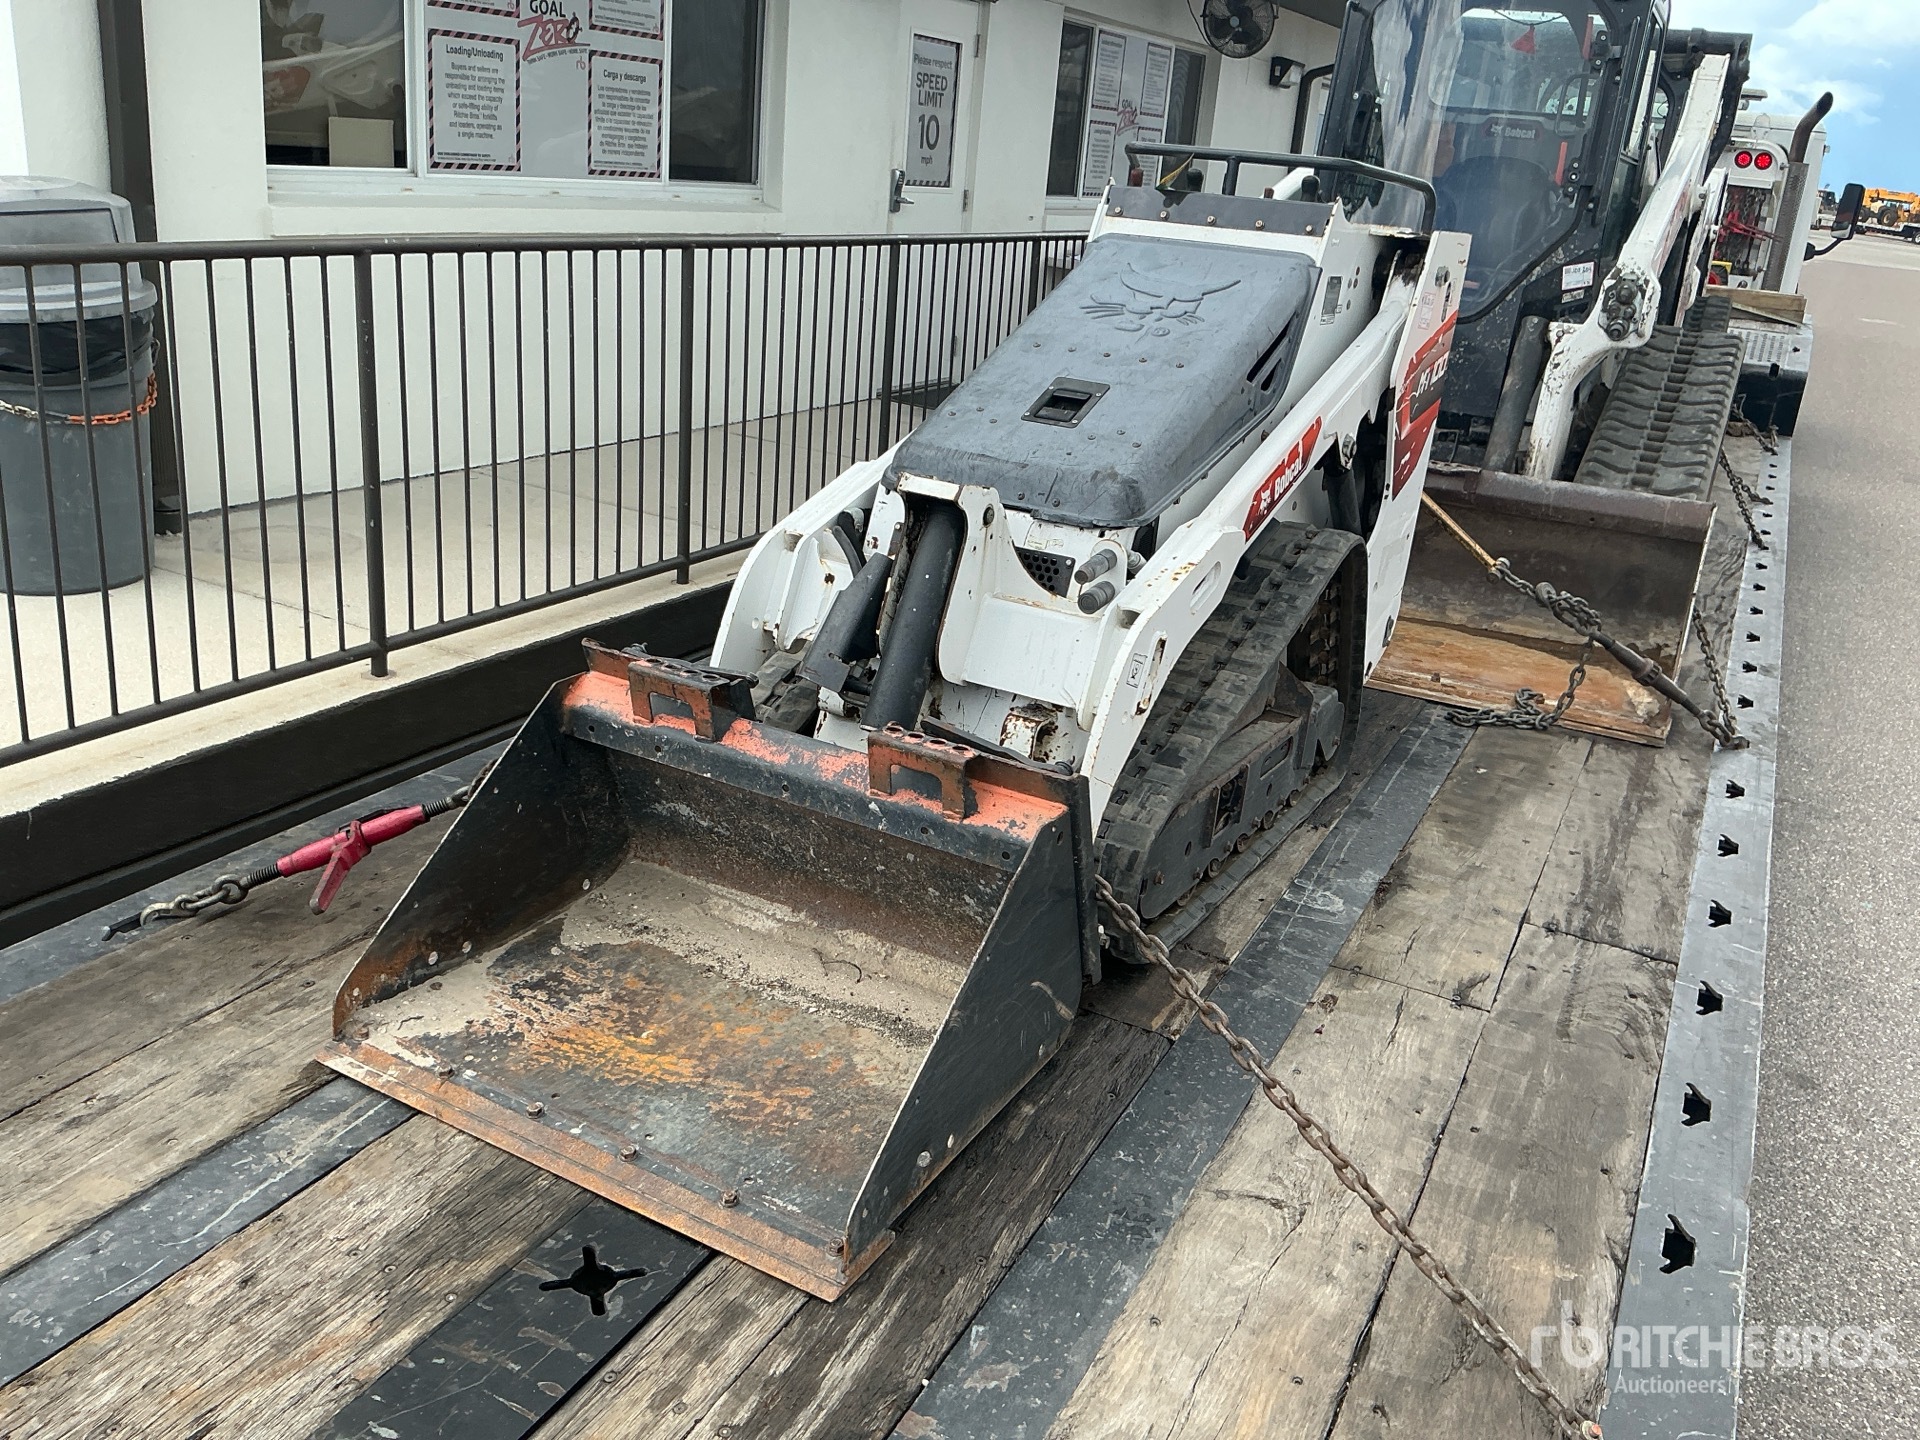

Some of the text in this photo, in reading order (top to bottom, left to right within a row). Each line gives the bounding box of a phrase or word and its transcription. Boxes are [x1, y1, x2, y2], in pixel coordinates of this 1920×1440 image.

[529, 0, 566, 18] GOAL
[517, 12, 590, 61] ZERO
[445, 44, 504, 62] Loading/Unloading
[913, 53, 953, 70] Please respect
[603, 69, 647, 84] Carga y descarga
[915, 72, 948, 91] SPEED
[918, 89, 944, 108] LIMIT
[918, 114, 940, 150] 10
[1504, 127, 1536, 139] Bobcat
[920, 154, 933, 167] mph
[1274, 450, 1302, 501] Bobcat
